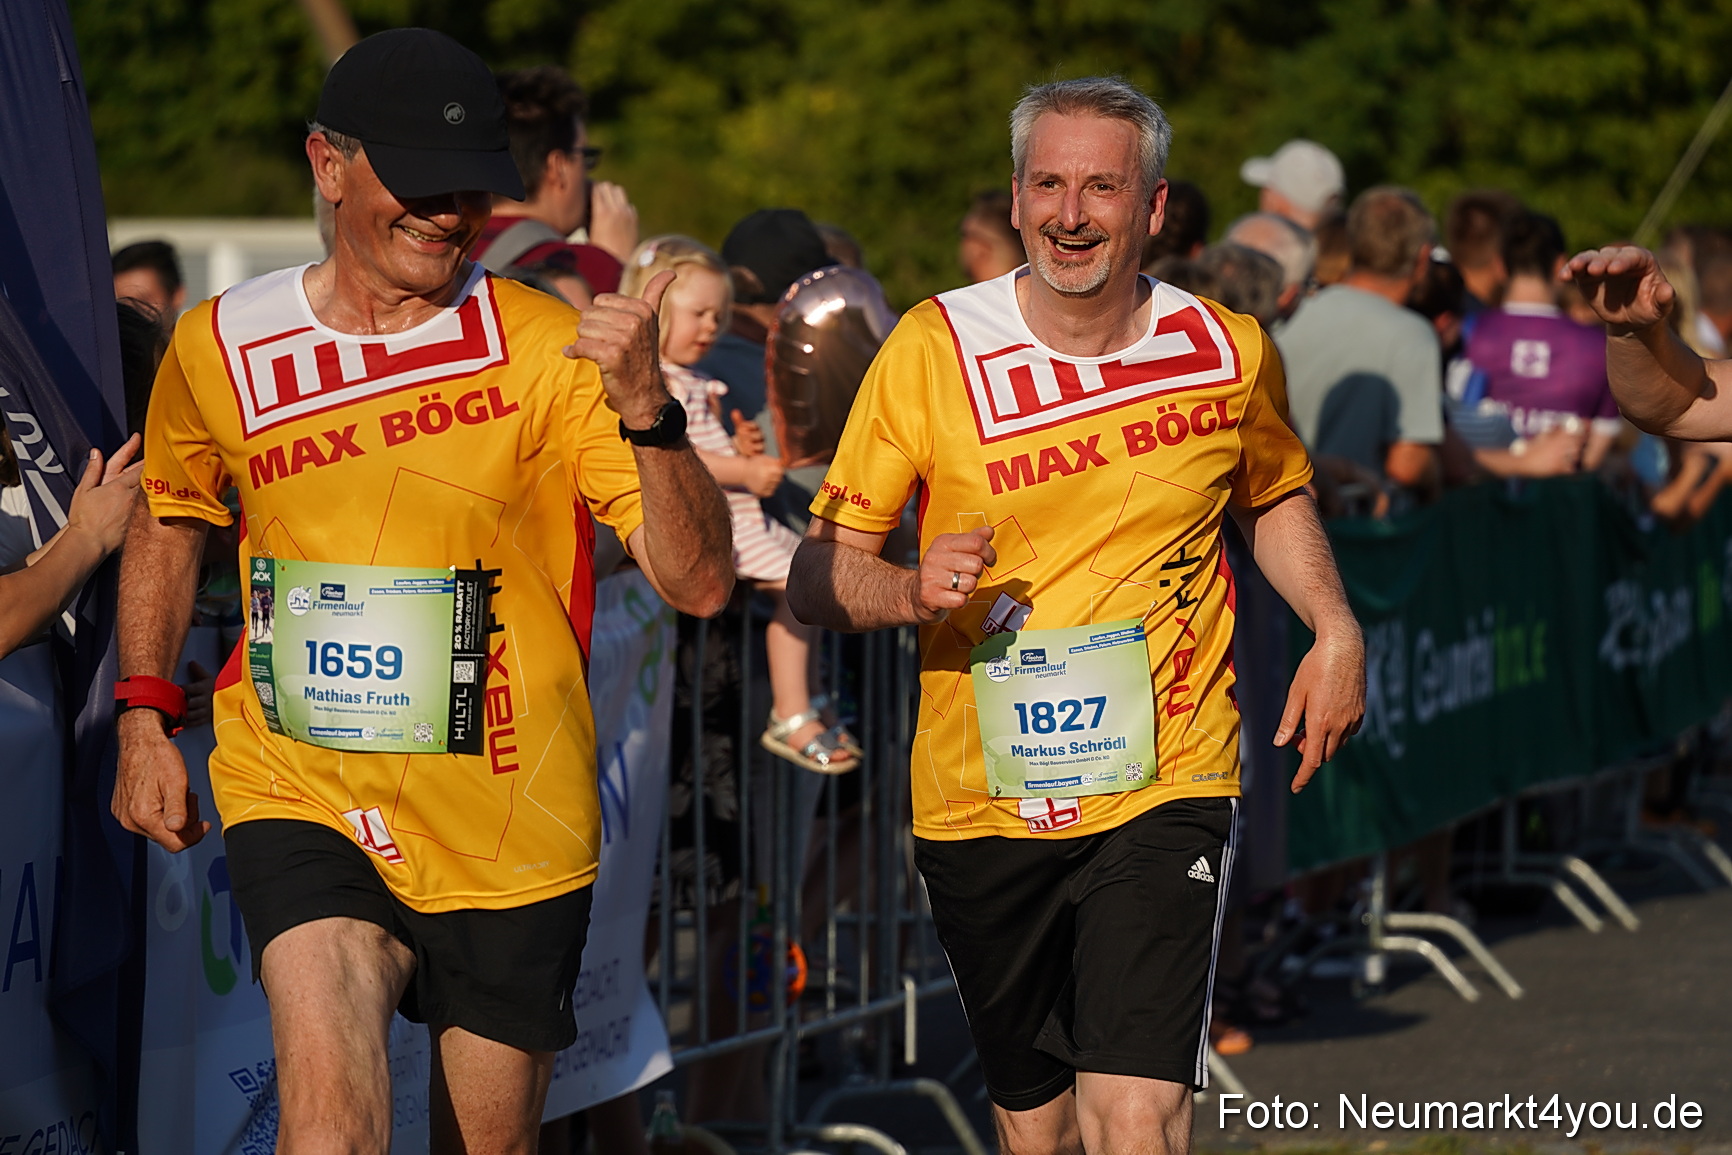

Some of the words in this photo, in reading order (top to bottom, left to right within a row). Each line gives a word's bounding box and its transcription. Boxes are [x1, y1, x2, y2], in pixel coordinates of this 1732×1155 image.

[248, 423, 367, 491] MAX
[379, 386, 520, 448] BÖGL
[985, 433, 1110, 496] MAX
[1121, 400, 1239, 458] BÖGL
[251, 571, 272, 582] AOK
[312, 601, 365, 611] Firmenlauf
[455, 580, 465, 624] RABATT
[466, 581, 474, 613] OUTLET
[454, 624, 462, 633] %
[464, 613, 473, 650] FACTORY
[454, 634, 462, 650] 20
[305, 640, 403, 681] 1659
[1014, 661, 1067, 675] Firmenlauf
[1035, 670, 1067, 679] neumarkt
[304, 686, 362, 704] Mathias
[366, 691, 410, 706] Fruth
[454, 687, 467, 740] HILTL
[1014, 696, 1107, 734] 1827
[1011, 742, 1066, 758] Markus
[1069, 737, 1127, 754] Schrödl
[1027, 779, 1079, 789] firmenlauf.bayern
[1187, 869, 1215, 883] adidas
